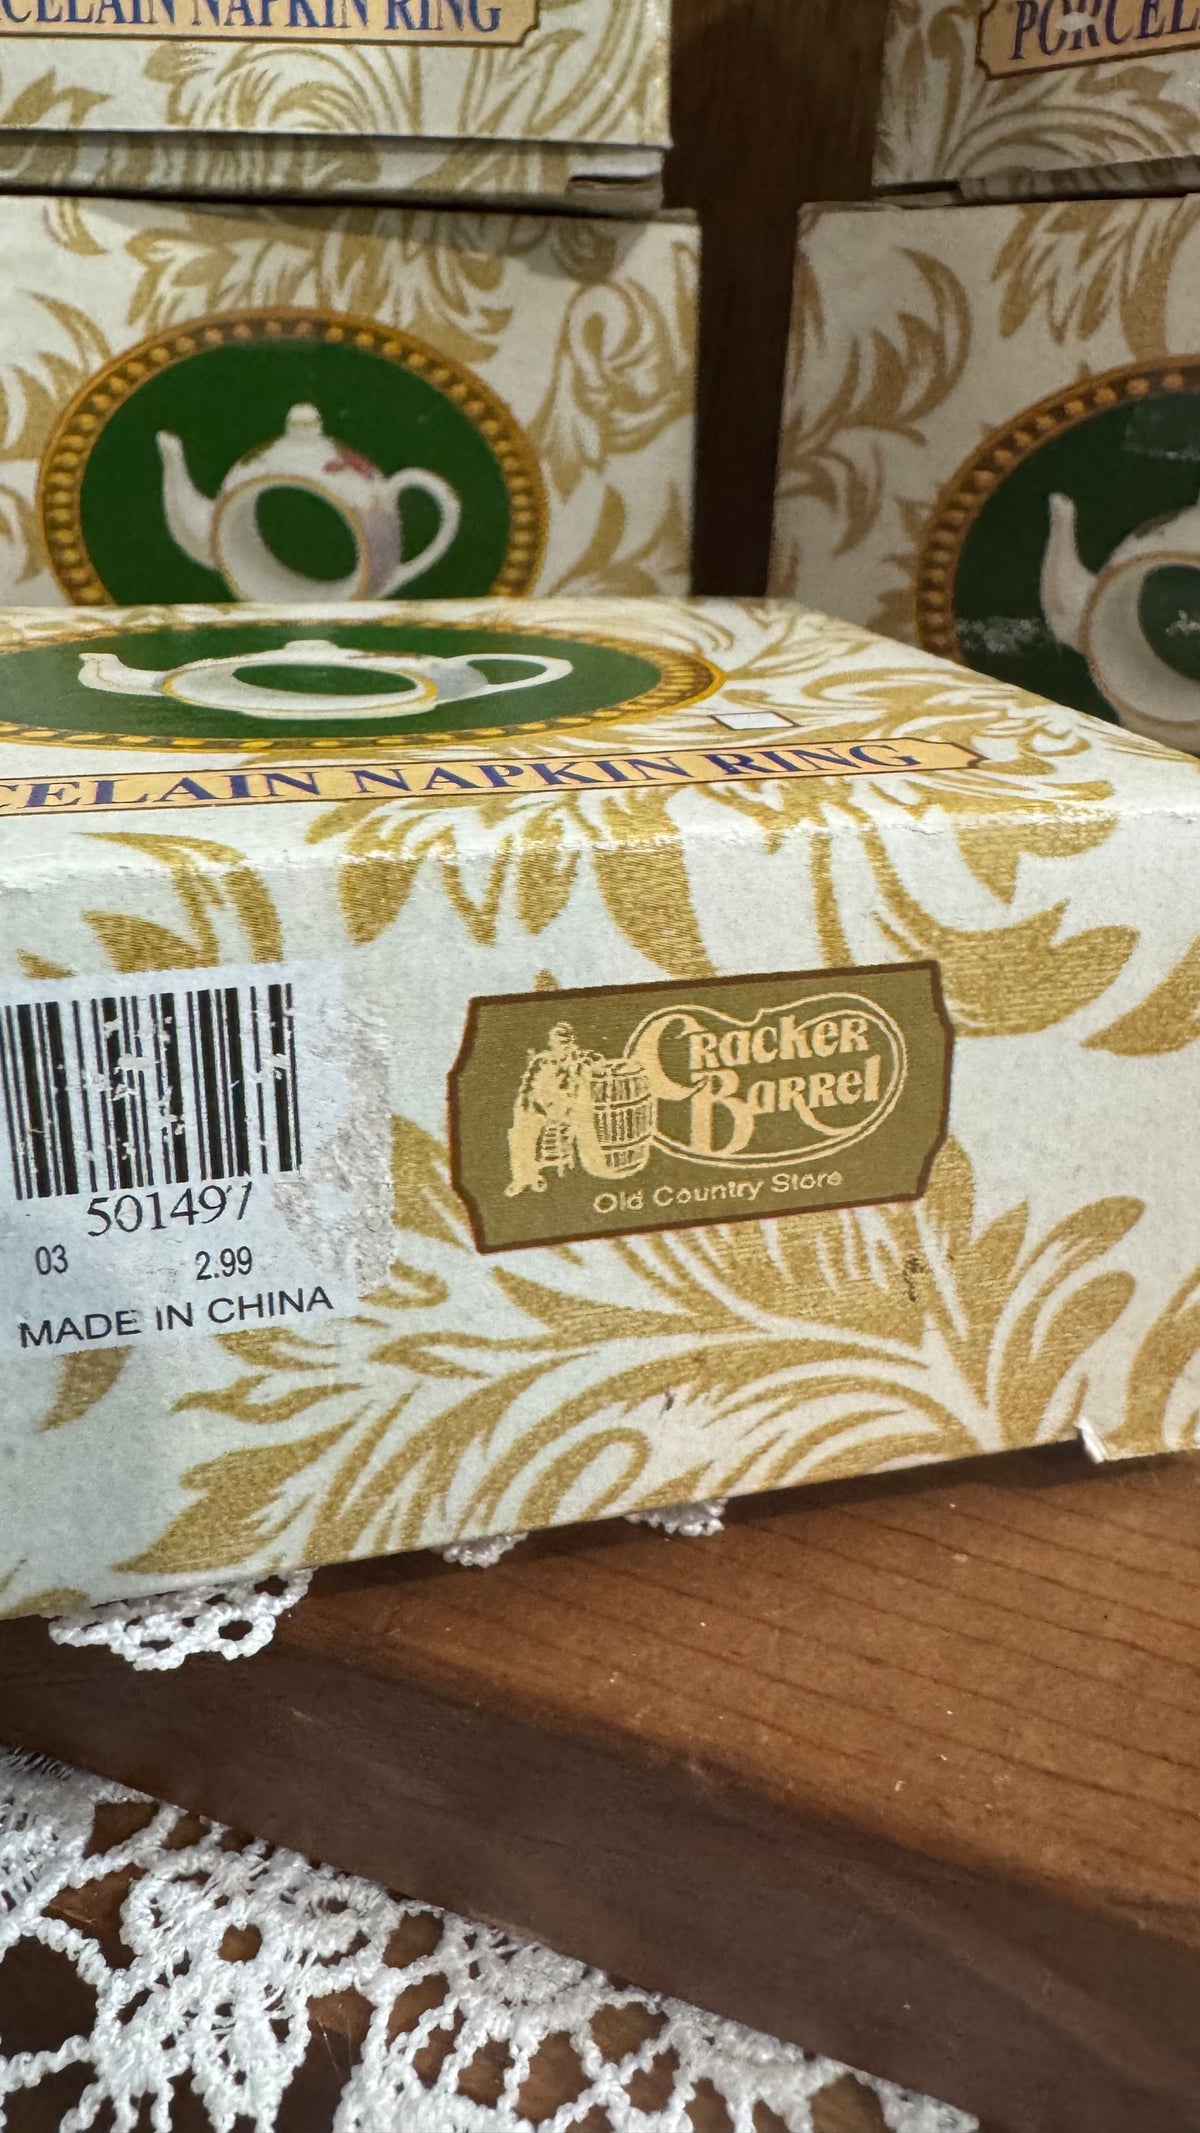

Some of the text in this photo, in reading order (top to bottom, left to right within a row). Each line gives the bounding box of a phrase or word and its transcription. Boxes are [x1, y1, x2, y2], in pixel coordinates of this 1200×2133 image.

[384, 0, 502, 33] RING
[347, 756, 692, 793] NAPKIN
[705, 743, 920, 775] RING
[593, 1171, 844, 1214] Old Country Store
[35, 1243, 253, 1281] 03 2.99
[19, 1286, 334, 1348] MADE IN CHINA
